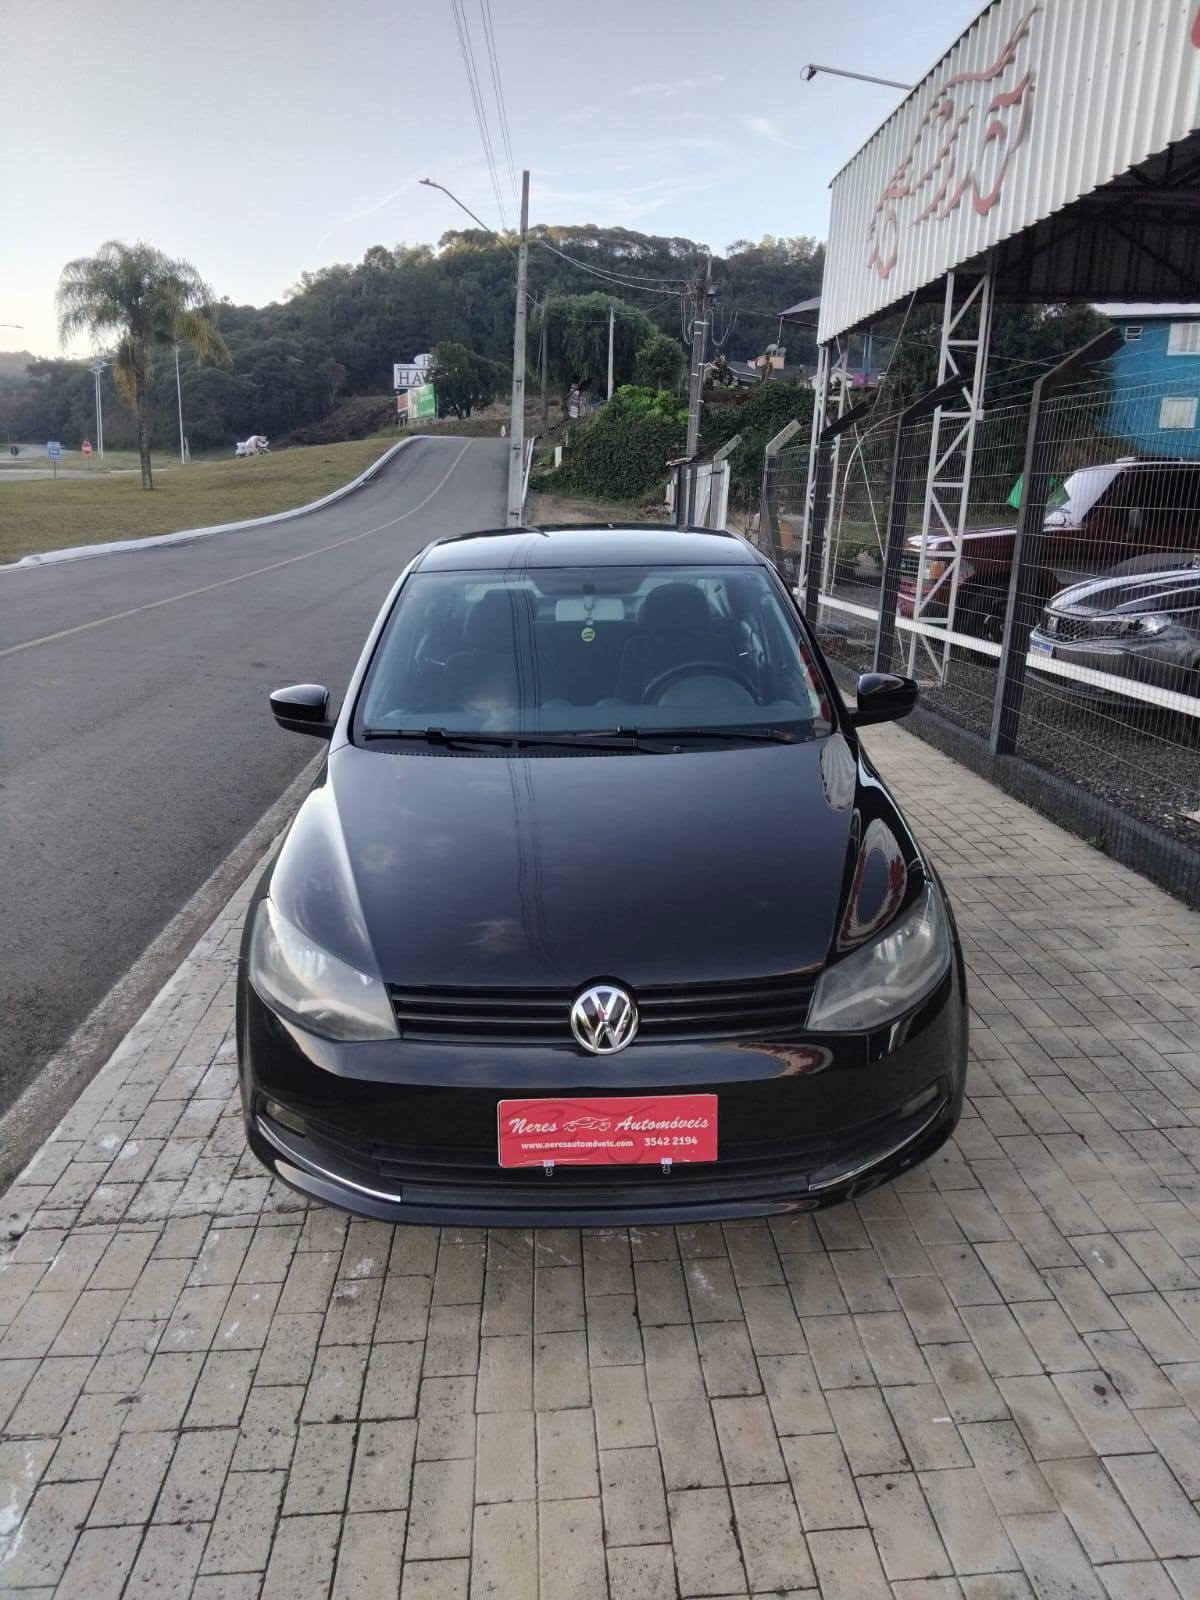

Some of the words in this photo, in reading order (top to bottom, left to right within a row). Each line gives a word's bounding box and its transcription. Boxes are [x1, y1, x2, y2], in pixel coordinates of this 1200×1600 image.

[508, 1117, 558, 1134] Neres
[614, 1115, 710, 1132] Automóveis
[644, 1136, 670, 1147] 3542
[672, 1135, 698, 1146] 2194
